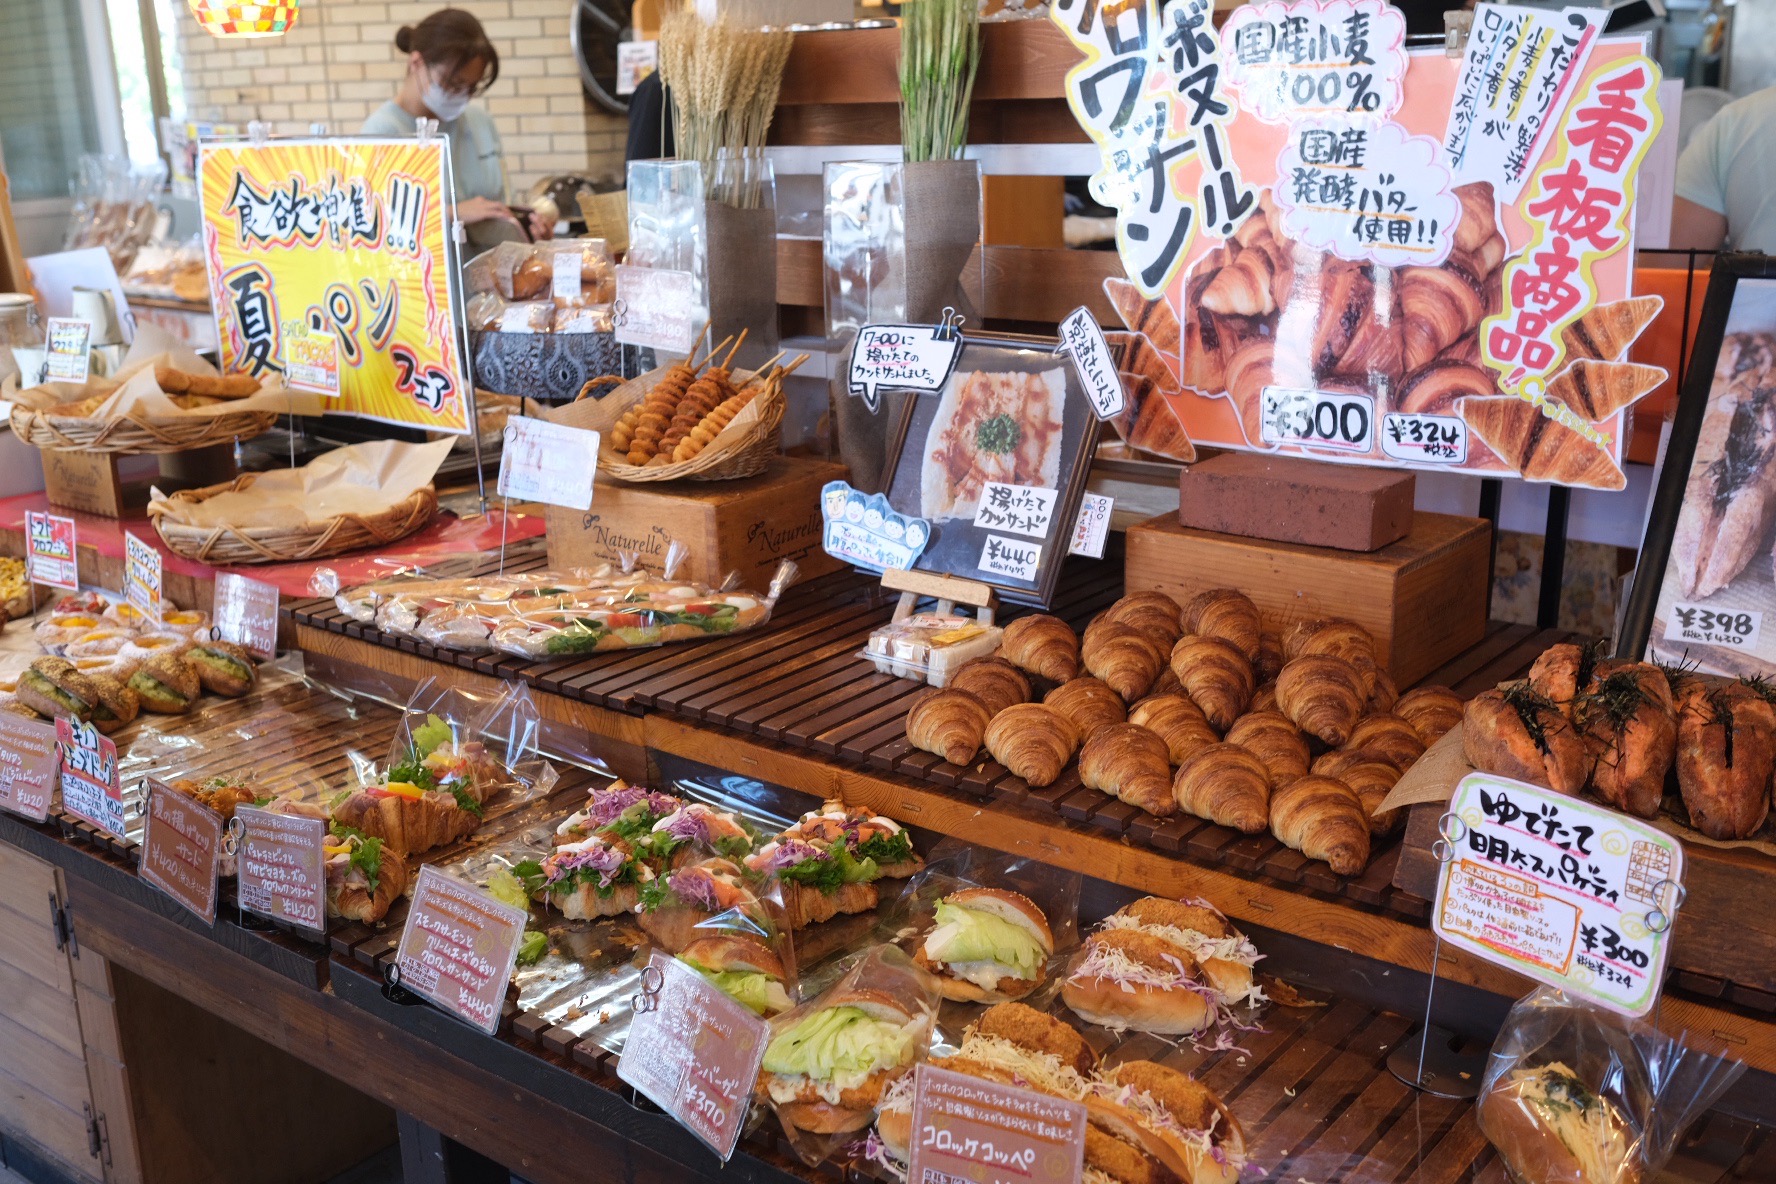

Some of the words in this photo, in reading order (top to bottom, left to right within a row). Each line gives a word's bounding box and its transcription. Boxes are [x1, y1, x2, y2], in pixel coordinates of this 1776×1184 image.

[1235, 10, 1376, 66] 国産小麦
[1505, 26, 1546, 120] 小麦の香り
[1503, 12, 1589, 185] こだわりの製法で
[1300, 126, 1367, 169] 国産
[1291, 166, 1418, 214] 発酵バター
[1352, 213, 1438, 245] 使用!!
[865, 346, 919, 364] 揚げたての
[391, 352, 452, 409] フェア
[1266, 394, 1370, 443] ¥300
[1519, 376, 1613, 448] Croissant
[1387, 417, 1459, 443] ¥324
[988, 485, 1047, 512] 揚げたて
[978, 506, 1048, 532] カツサンド
[593, 525, 662, 555] Naturelle
[987, 538, 1037, 565] ¥440
[1674, 606, 1754, 636] ¥398
[0, 747, 23, 766] タリアン
[16, 787, 44, 808] ¥420
[1479, 787, 1595, 857] ゆでたて
[151, 842, 179, 877] ¥420
[282, 897, 317, 920] ¥420
[1580, 922, 1650, 969] ¥300
[458, 986, 494, 1019] ¥440
[685, 1080, 726, 1128] ¥370
[921, 1124, 1037, 1172] コロッケコッペ
